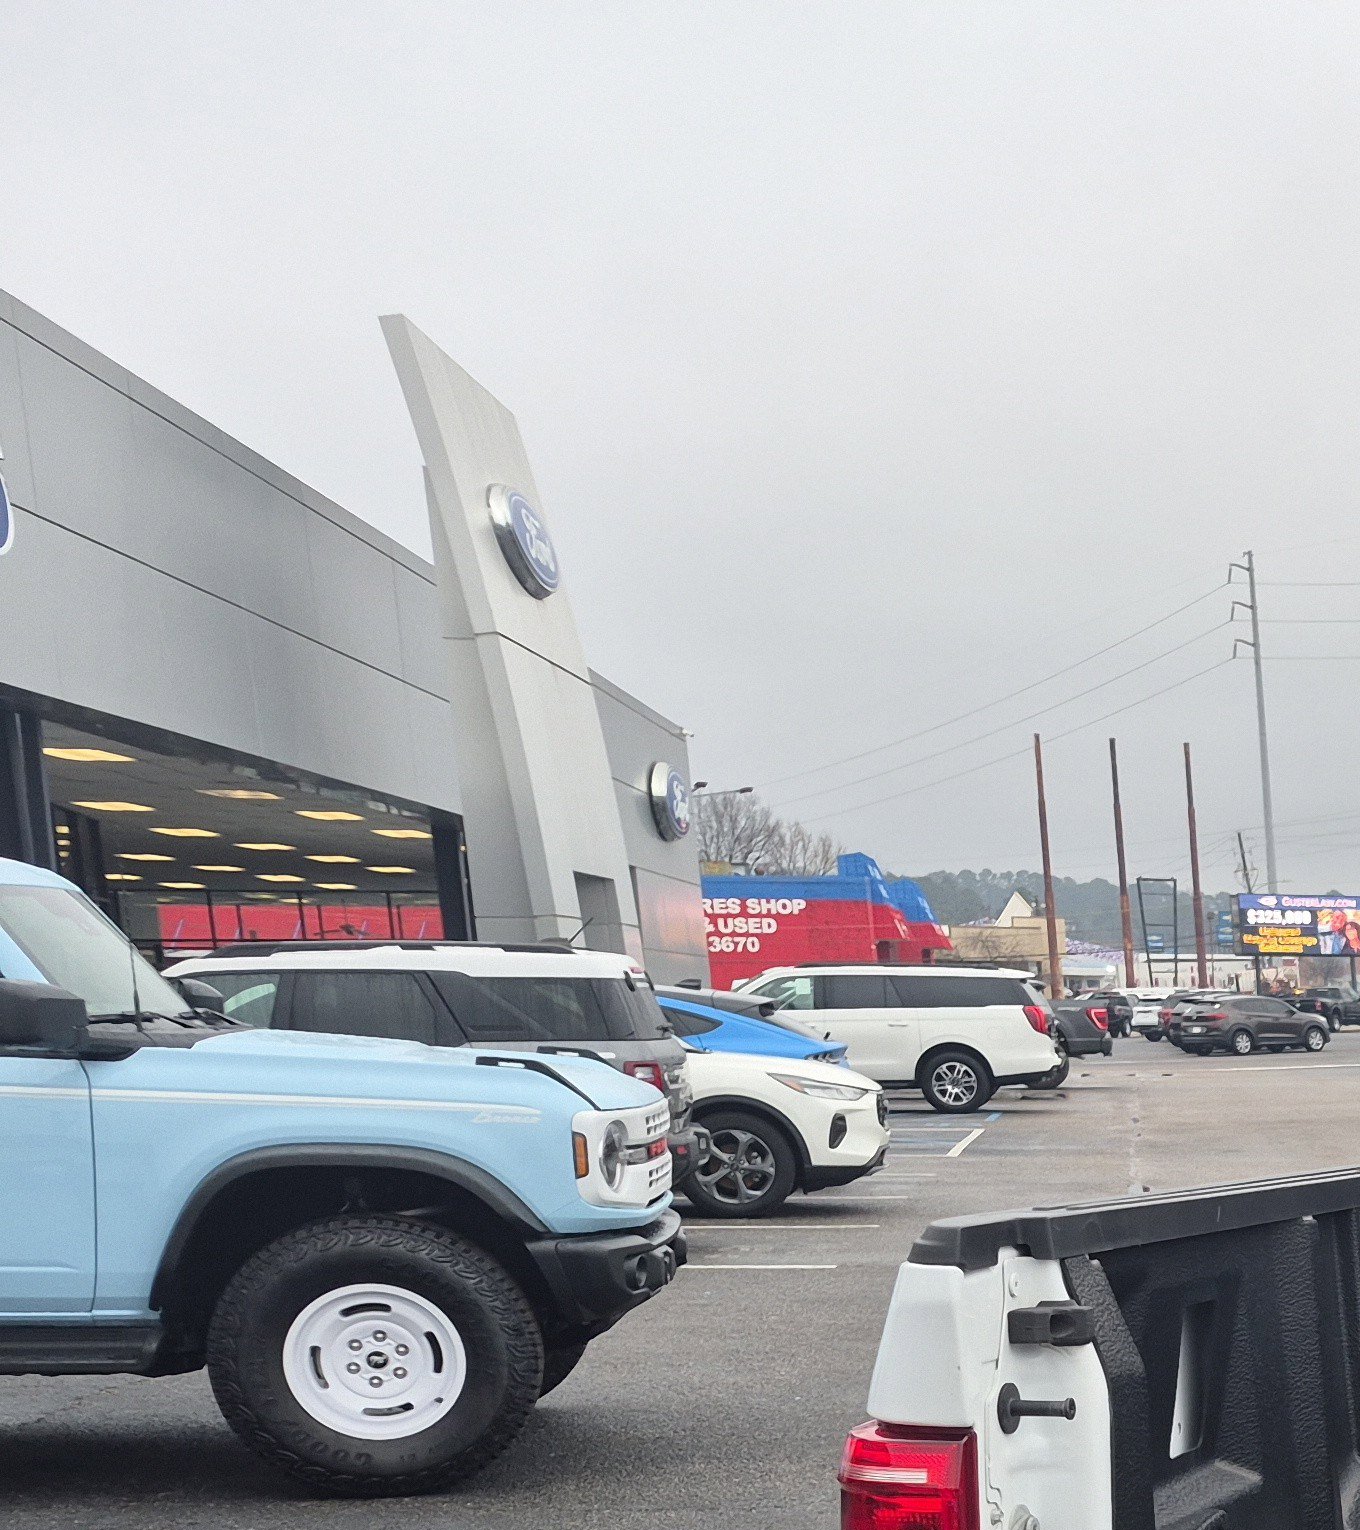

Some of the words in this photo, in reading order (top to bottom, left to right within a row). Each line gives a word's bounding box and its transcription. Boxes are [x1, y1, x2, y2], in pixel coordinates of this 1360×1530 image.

[521, 507, 556, 573] Ford
[702, 898, 741, 914] RES
[745, 898, 806, 914] SHOP
[717, 917, 778, 934] USED
[708, 935, 760, 952] 3670
